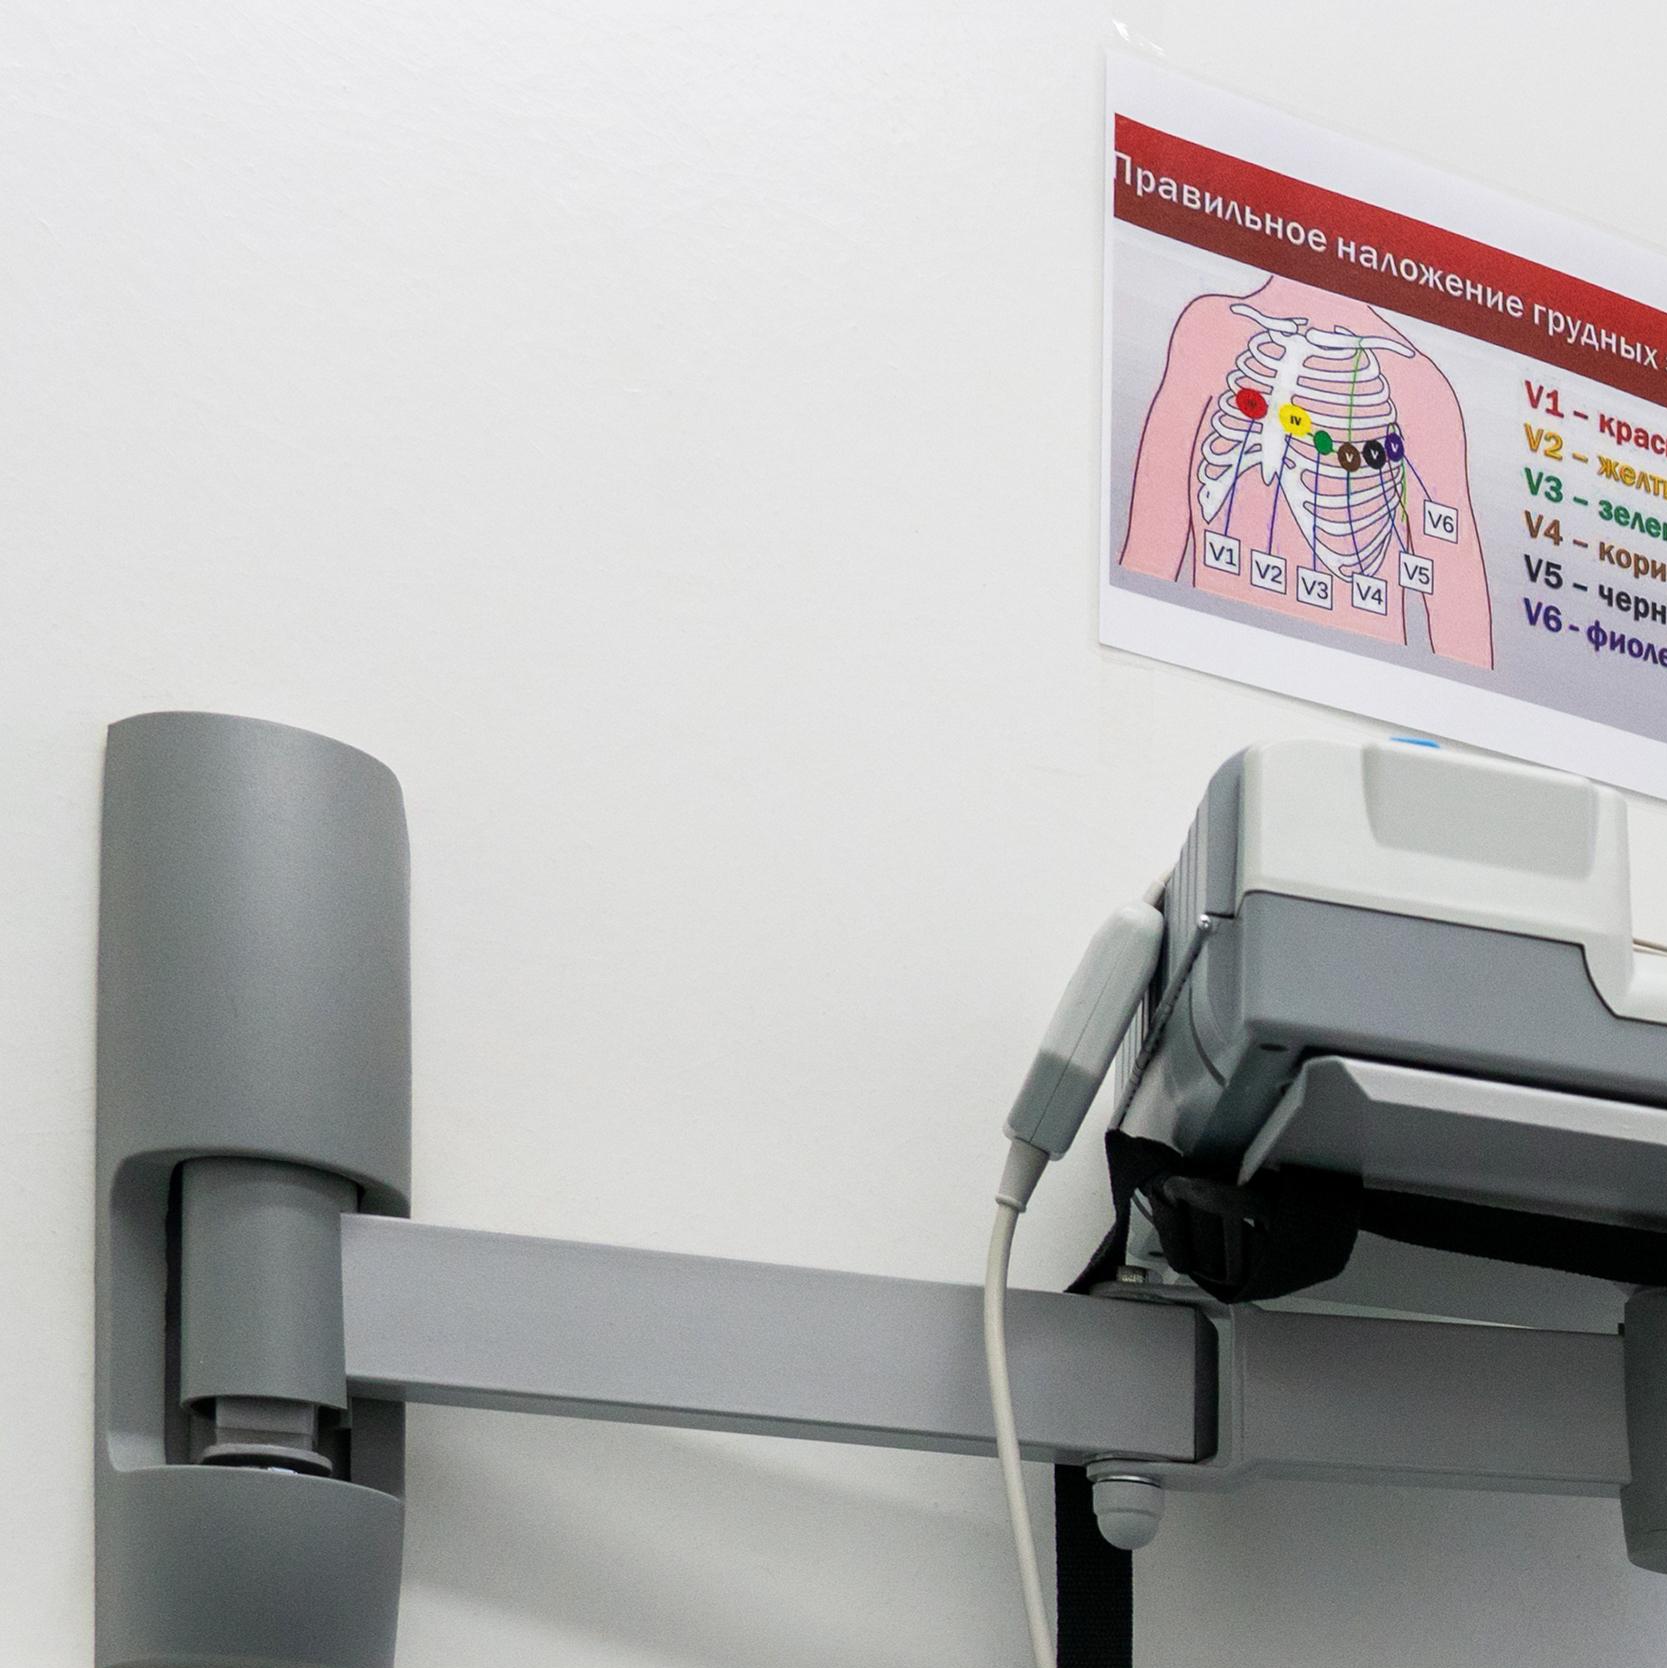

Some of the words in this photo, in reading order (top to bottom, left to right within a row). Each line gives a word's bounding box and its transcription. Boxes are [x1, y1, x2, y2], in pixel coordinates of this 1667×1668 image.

[1114, 150, 1327, 253] Правильное
[1338, 236, 1524, 317] наложение
[1532, 303, 1659, 371] грудных
[1524, 379, 1565, 419] V1
[1524, 423, 1564, 461] V2
[1524, 466, 1564, 503] V3
[1428, 510, 1455, 533] V6
[1524, 510, 1564, 546] V4
[1209, 541, 1237, 567] V1
[1255, 559, 1283, 584] V2
[1523, 554, 1563, 589] V5
[1301, 576, 1329, 600] V3
[1403, 561, 1430, 585] V5
[1355, 582, 1384, 605] V4
[1523, 597, 1563, 633] V6
